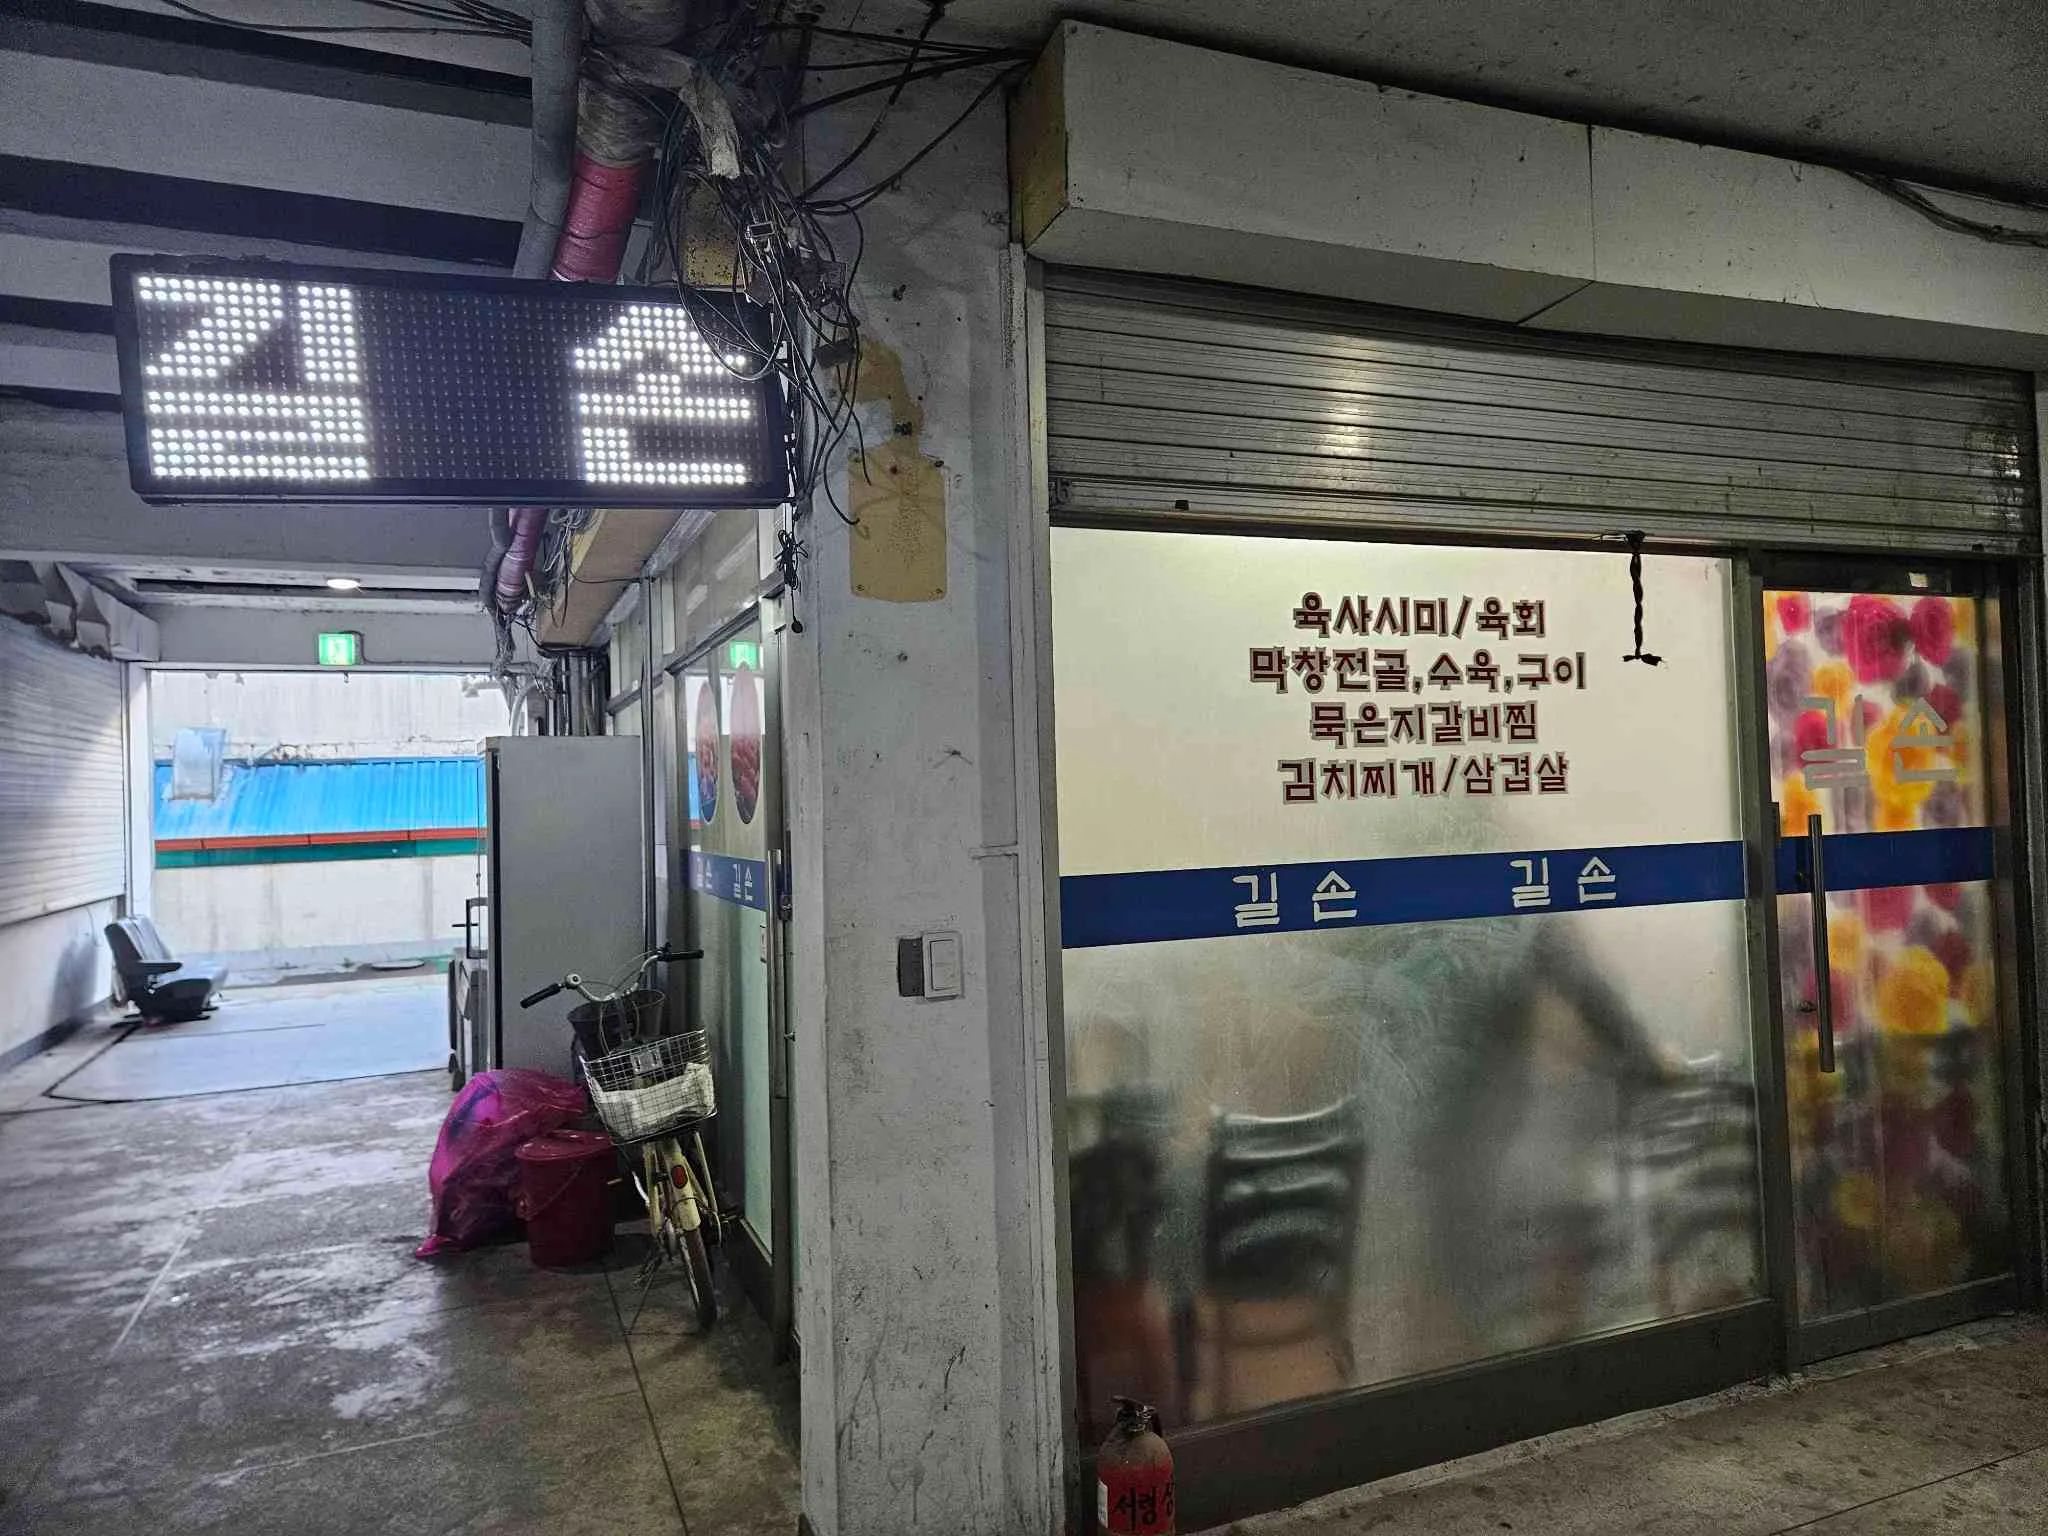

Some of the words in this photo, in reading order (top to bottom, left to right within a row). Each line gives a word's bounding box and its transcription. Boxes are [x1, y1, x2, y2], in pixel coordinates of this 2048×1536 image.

[138, 275, 369, 479] 길
[1293, 591, 1546, 640] 육사시미/육회
[1249, 646, 1587, 694] 막창전골,수육,구이
[1310, 700, 1539, 750] 묵은지갈비찜
[1800, 692, 1869, 791] 길
[1893, 697, 1958, 784] 손
[1278, 752, 1570, 804] 김치찌개/삼겹살
[1232, 872, 1280, 928] 길
[1311, 870, 1359, 923] 손
[1510, 856, 1552, 909] 길
[1577, 855, 1618, 904] 손
